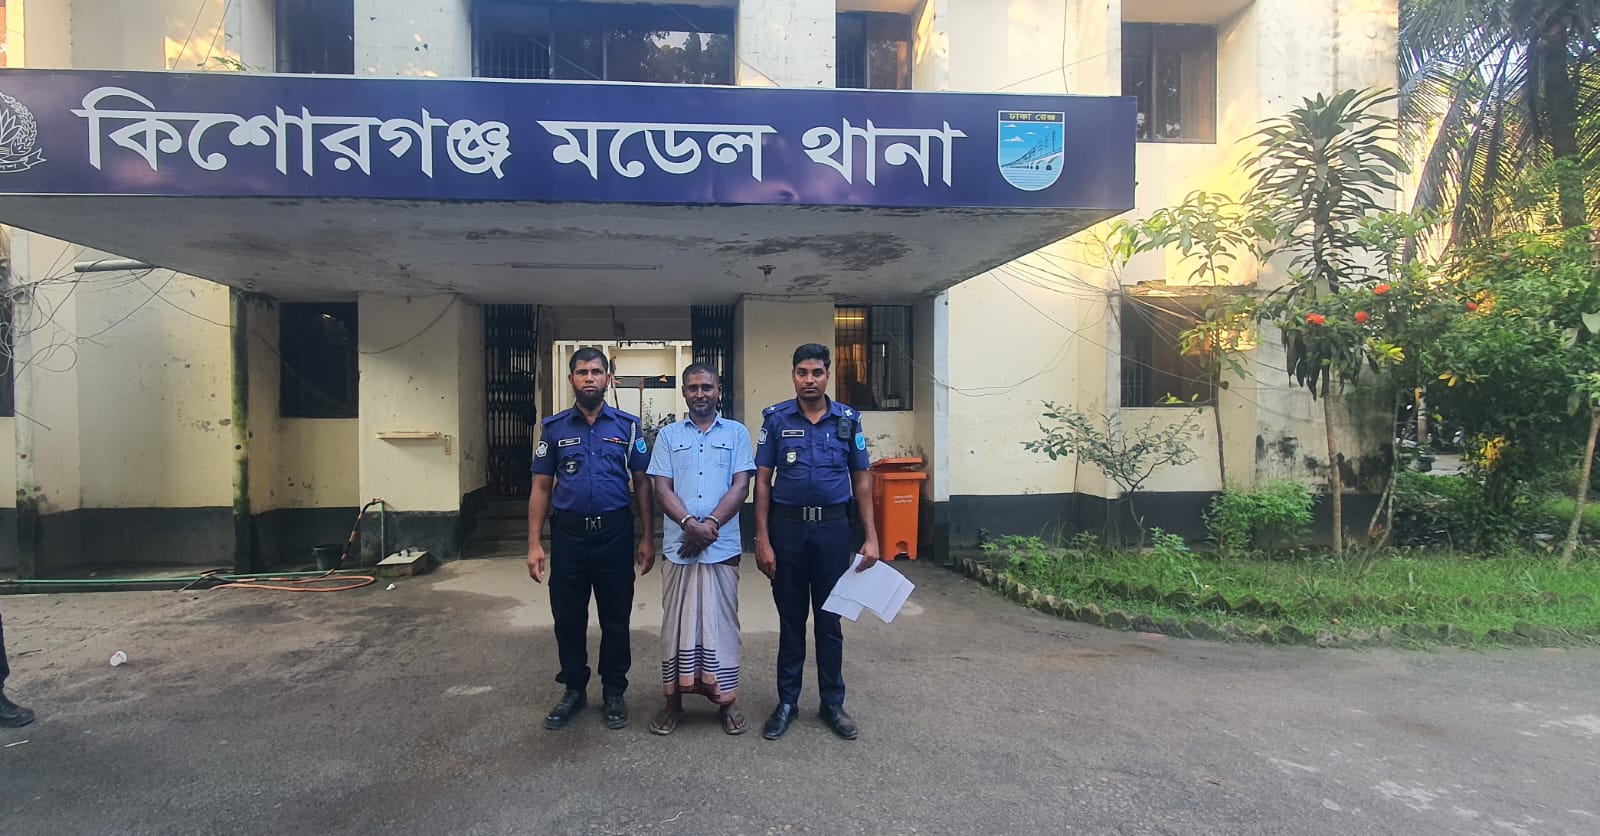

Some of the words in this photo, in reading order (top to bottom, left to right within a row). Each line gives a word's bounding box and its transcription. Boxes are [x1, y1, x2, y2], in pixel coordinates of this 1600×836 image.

[70, 86, 512, 179] কিশোরগঞ্জ
[536, 120, 778, 182] মডেল
[802, 117, 967, 187] থানা
[1009, 112, 1032, 120] ঢাকা
